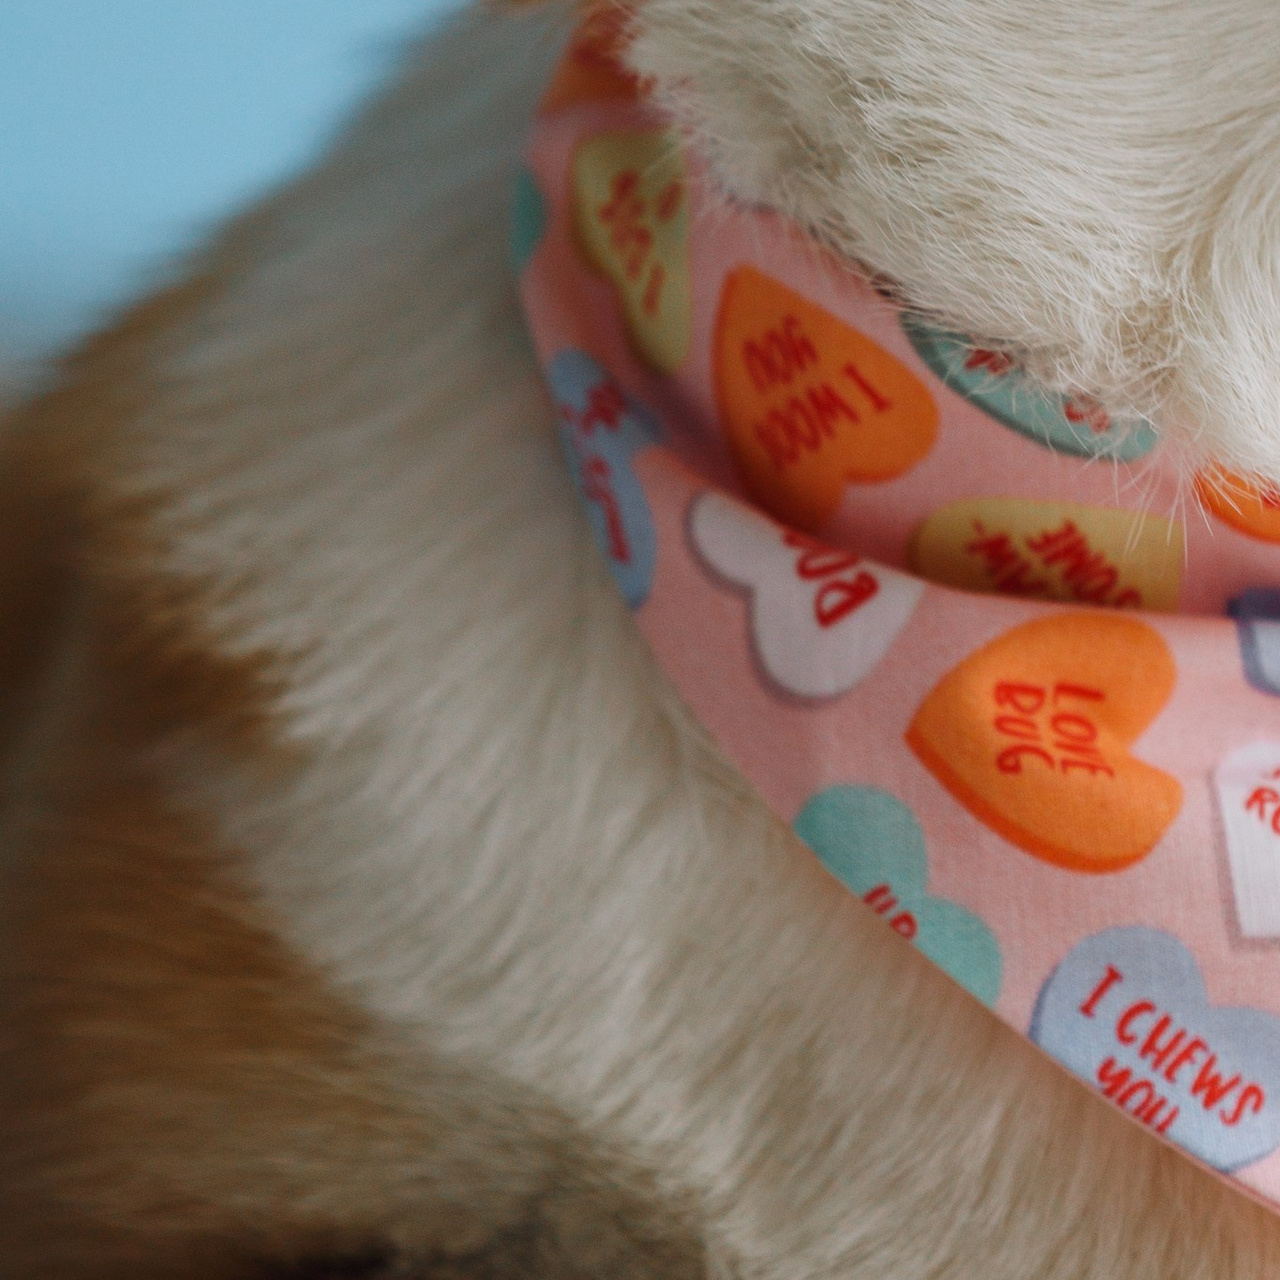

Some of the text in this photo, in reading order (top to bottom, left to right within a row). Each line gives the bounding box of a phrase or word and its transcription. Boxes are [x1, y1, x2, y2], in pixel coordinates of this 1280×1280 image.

[742, 314, 820, 395] YOU
[841, 363, 892, 412] I
[1050, 681, 1116, 779] LOVE
[1079, 963, 1265, 1129] I CHEWS
